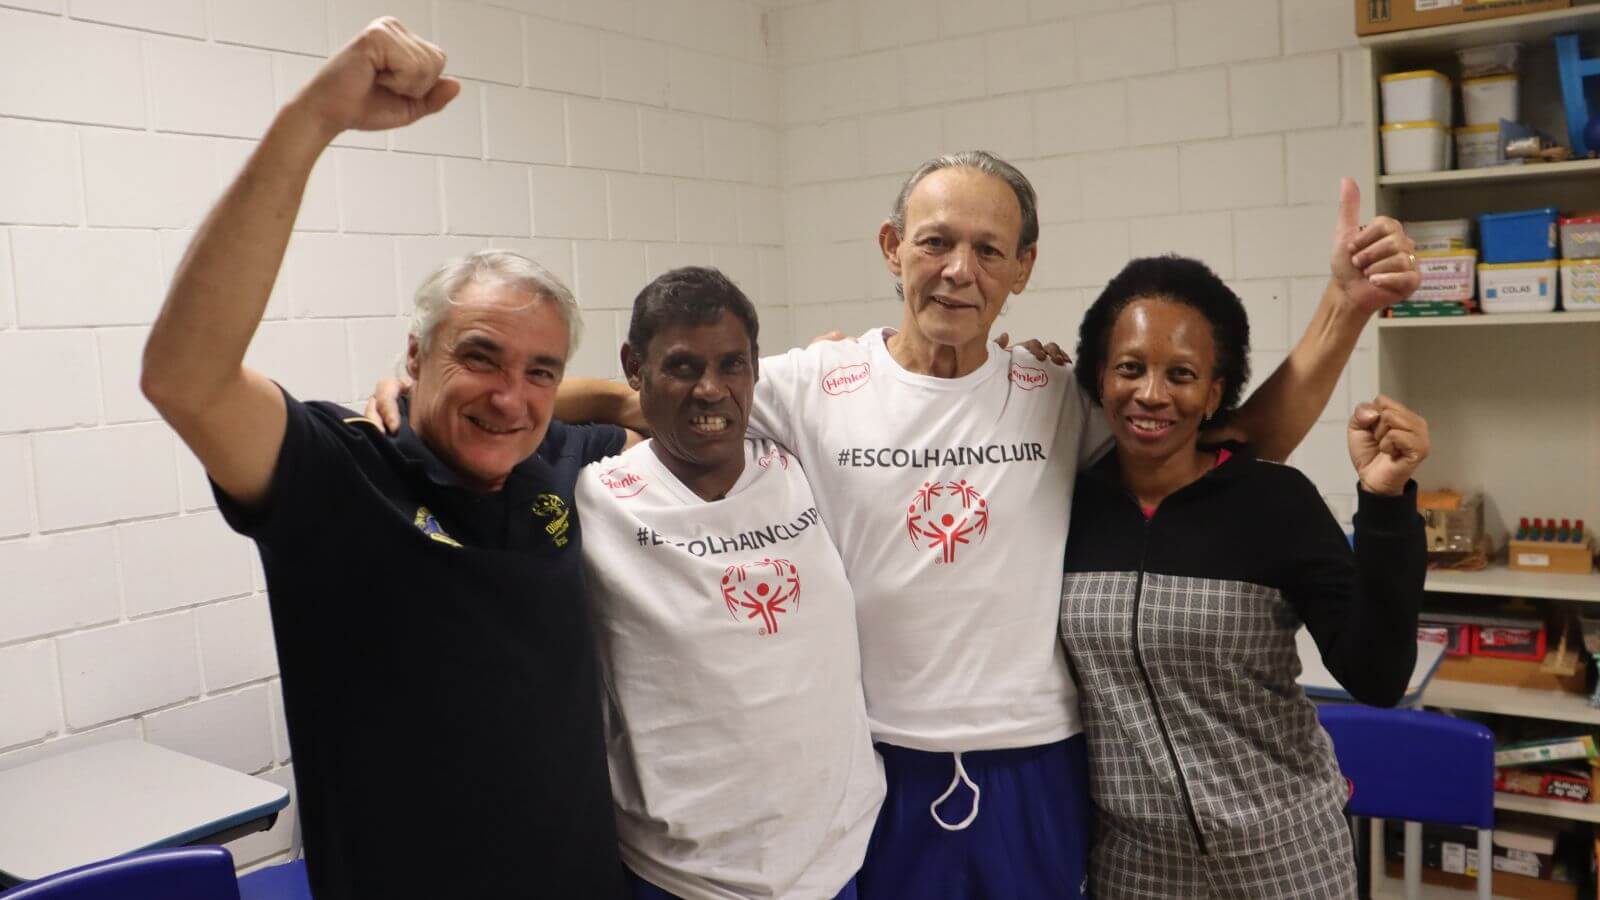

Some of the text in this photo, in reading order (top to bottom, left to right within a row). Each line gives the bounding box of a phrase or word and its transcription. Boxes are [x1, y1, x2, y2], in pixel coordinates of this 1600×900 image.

[826, 364, 868, 391] Henkel
[1012, 369, 1045, 384] enkel
[837, 442, 1047, 468] #ESCOLHAINCLUIR
